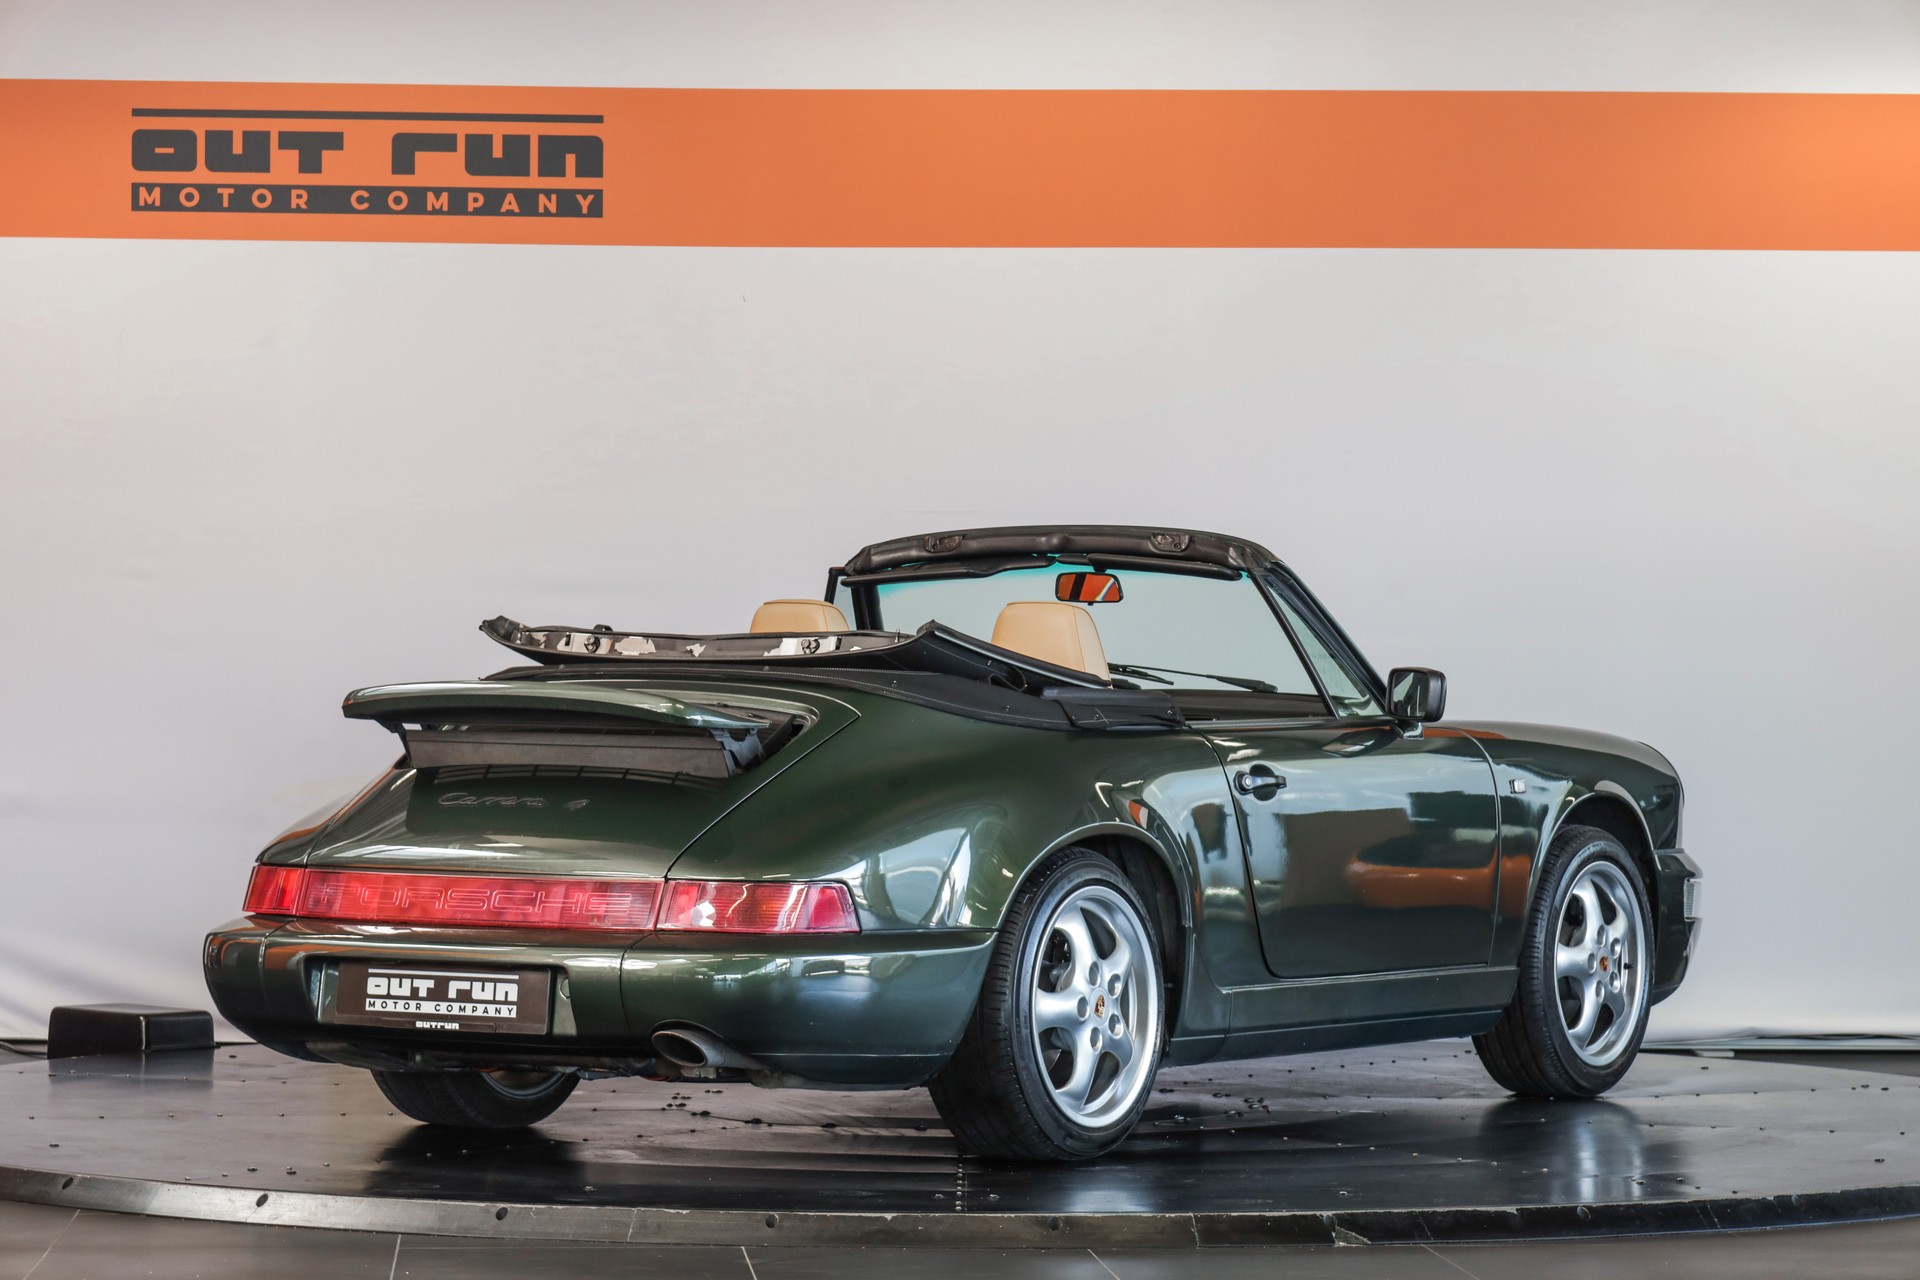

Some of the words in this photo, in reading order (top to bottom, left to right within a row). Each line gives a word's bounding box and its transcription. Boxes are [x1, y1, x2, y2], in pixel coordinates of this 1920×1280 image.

[138, 186, 308, 210] MOTOR
[350, 190, 595, 214] COMPANY
[438, 792, 546, 806] Carrera
[320, 882, 633, 916] PORSCHE
[368, 1000, 422, 1011] MOTOR
[434, 1003, 514, 1016] COMPANY
